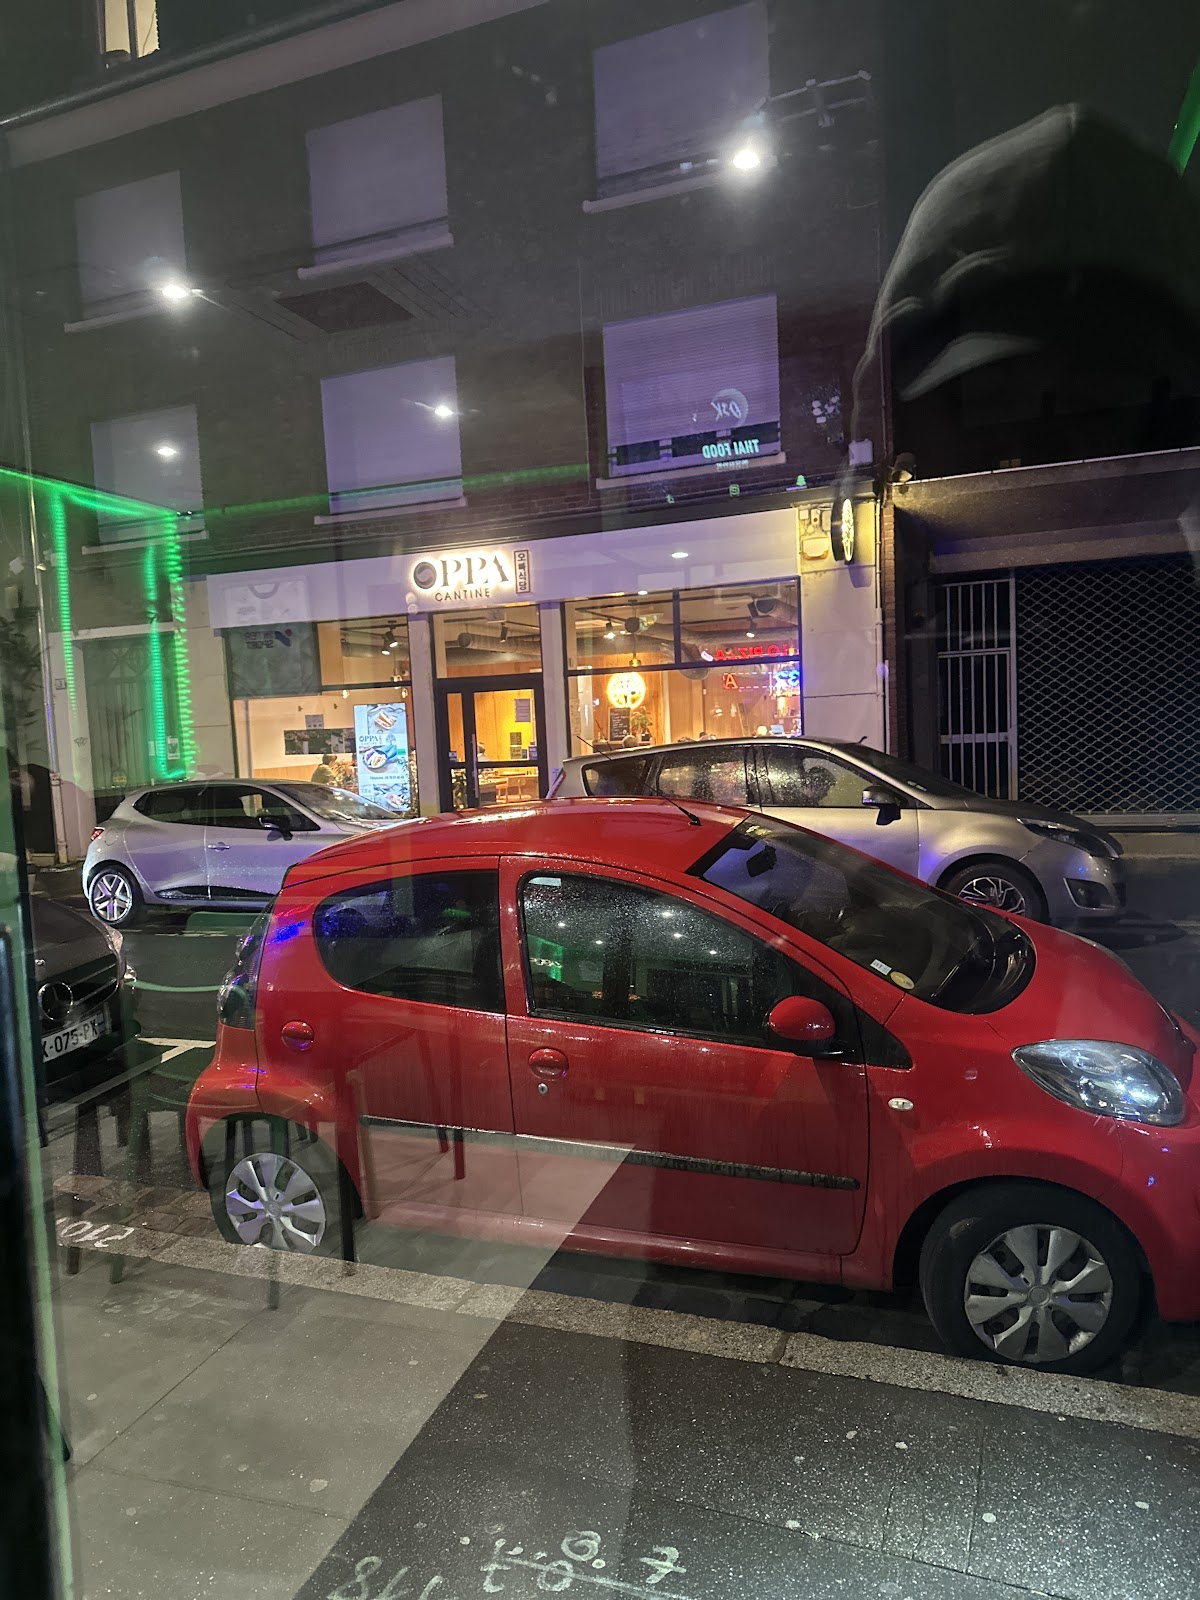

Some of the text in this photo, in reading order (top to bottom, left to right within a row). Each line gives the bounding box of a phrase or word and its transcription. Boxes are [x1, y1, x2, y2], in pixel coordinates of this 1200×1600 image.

[413, 555, 509, 590] OPPA
[434, 588, 491, 602] CANTINE
[358, 735, 379, 743] OPPA
